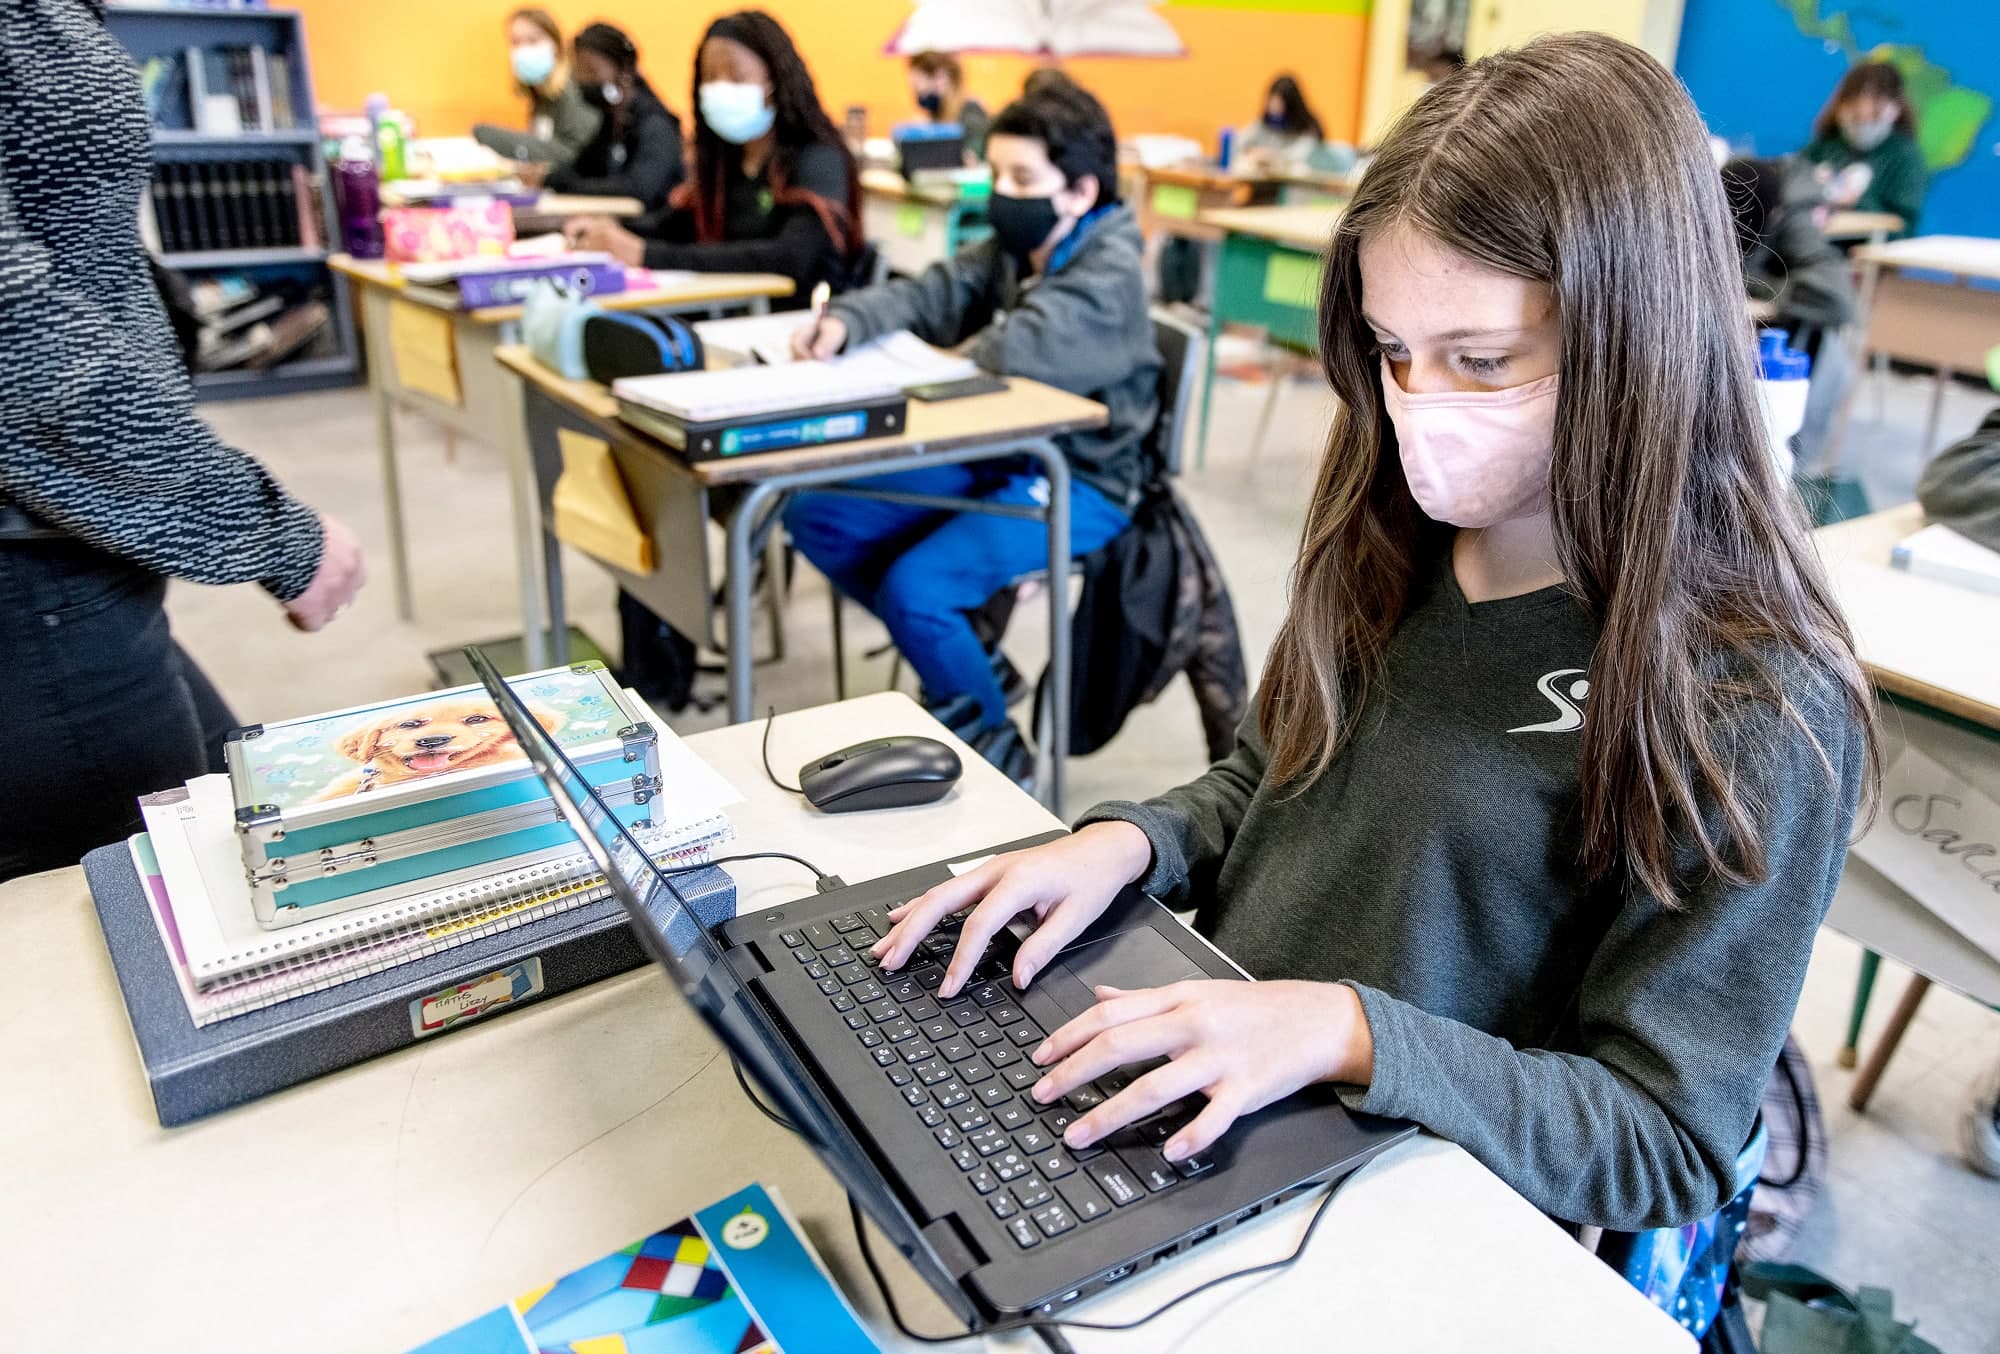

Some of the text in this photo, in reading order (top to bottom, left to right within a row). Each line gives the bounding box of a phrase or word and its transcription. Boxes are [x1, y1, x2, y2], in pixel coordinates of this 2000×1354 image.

[982, 990, 992, 998] M
[978, 1030, 989, 1038] H
[988, 1088, 998, 1097] R
[1077, 1093, 1089, 1101] X
[1007, 1111, 1018, 1119] E
[1025, 1134, 1039, 1145] W
[1048, 1158, 1060, 1168] Q
